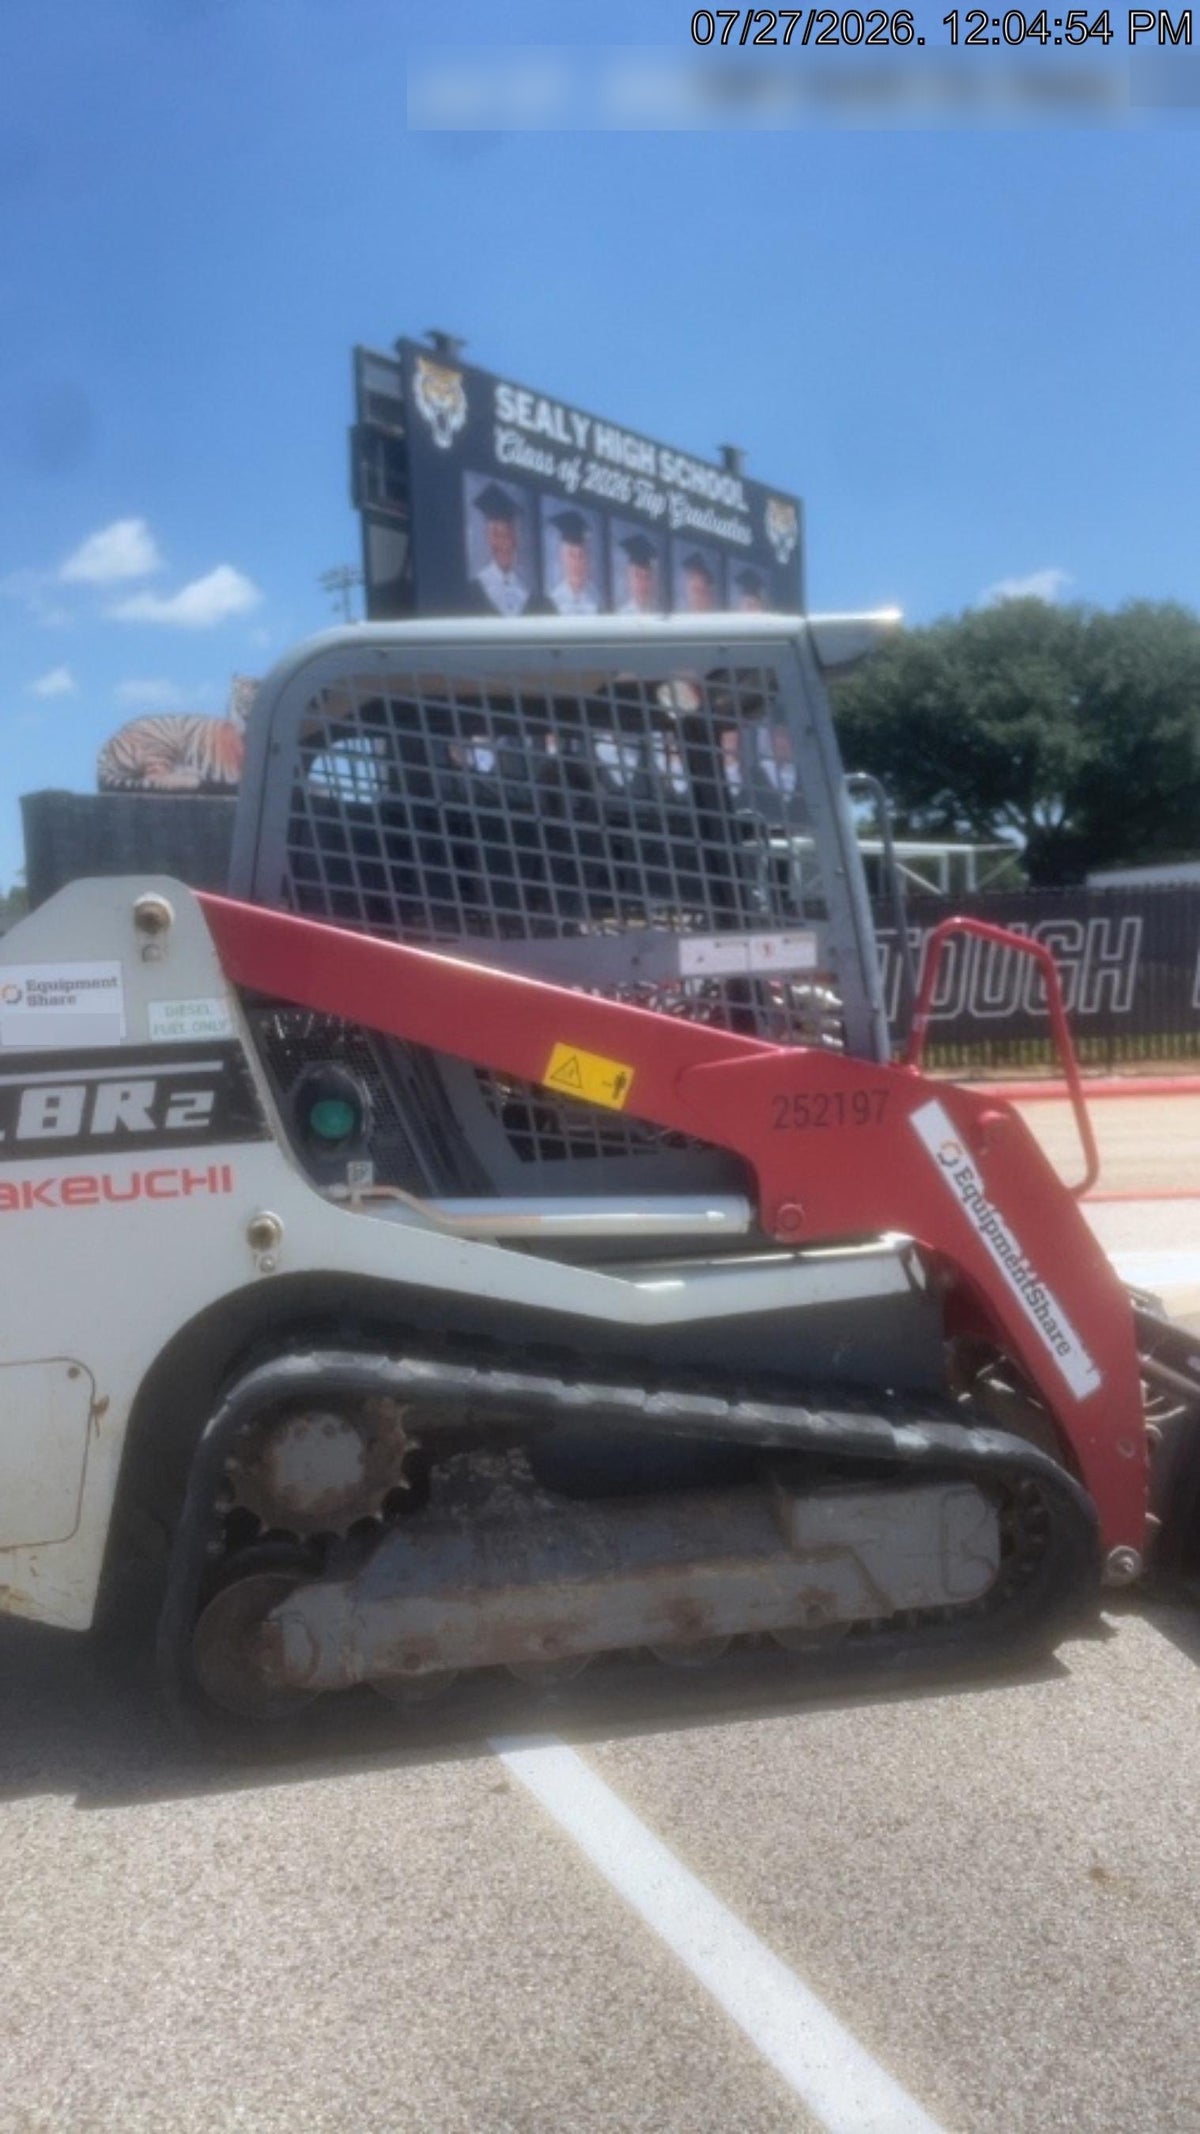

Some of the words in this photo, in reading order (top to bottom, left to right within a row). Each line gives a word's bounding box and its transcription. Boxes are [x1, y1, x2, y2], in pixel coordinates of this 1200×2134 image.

[494, 382, 591, 450] SEALY
[592, 422, 656, 475] HIGH
[658, 450, 749, 513] SCHOOL
[494, 426, 554, 476] Class
[557, 455, 582, 494] of
[632, 477, 666, 520] Top
[667, 489, 753, 546] Graduates
[26, 976, 118, 994] Equipment
[872, 916, 1143, 1023] TOUGH
[27, 994, 77, 1007] Share
[165, 1003, 211, 1018] DIESEL
[154, 1022, 185, 1035] FUEL
[192, 1018, 228, 1032] ONLY
[772, 1091, 889, 1130] 252197
[953, 1164, 1072, 1357] EquipmentShare
